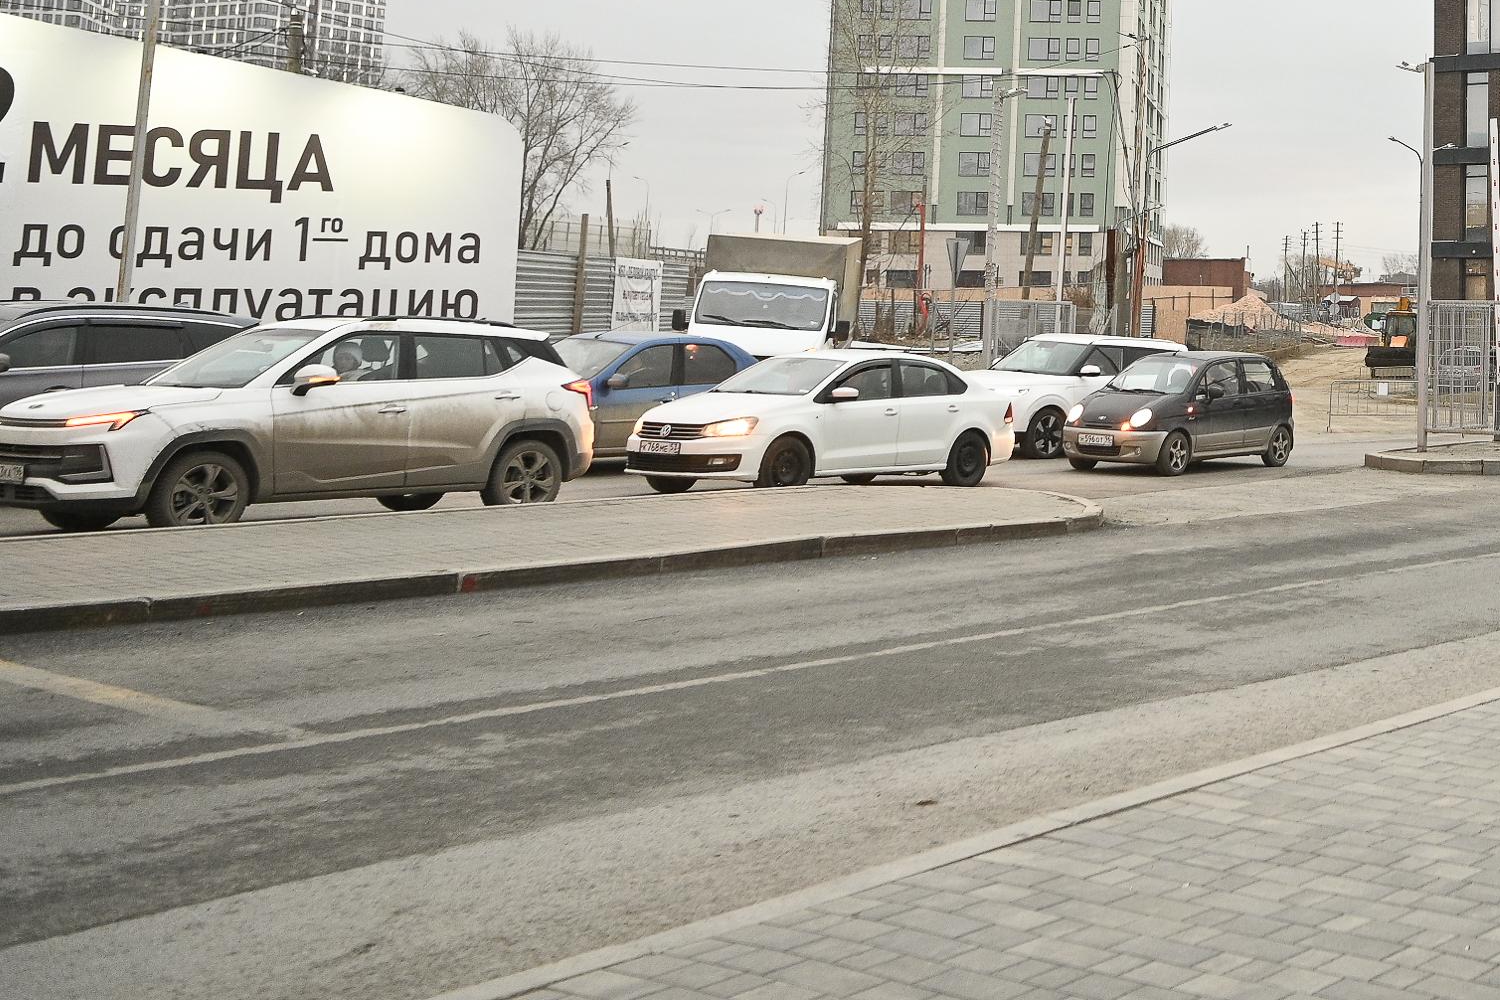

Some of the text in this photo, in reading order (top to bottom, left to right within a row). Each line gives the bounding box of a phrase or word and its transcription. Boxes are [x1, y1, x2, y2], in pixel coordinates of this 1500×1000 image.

[27, 120, 334, 204] МЕСЯЦА
[12, 223, 86, 267] до
[108, 224, 273, 268] сдачи
[358, 230, 481, 271] дома
